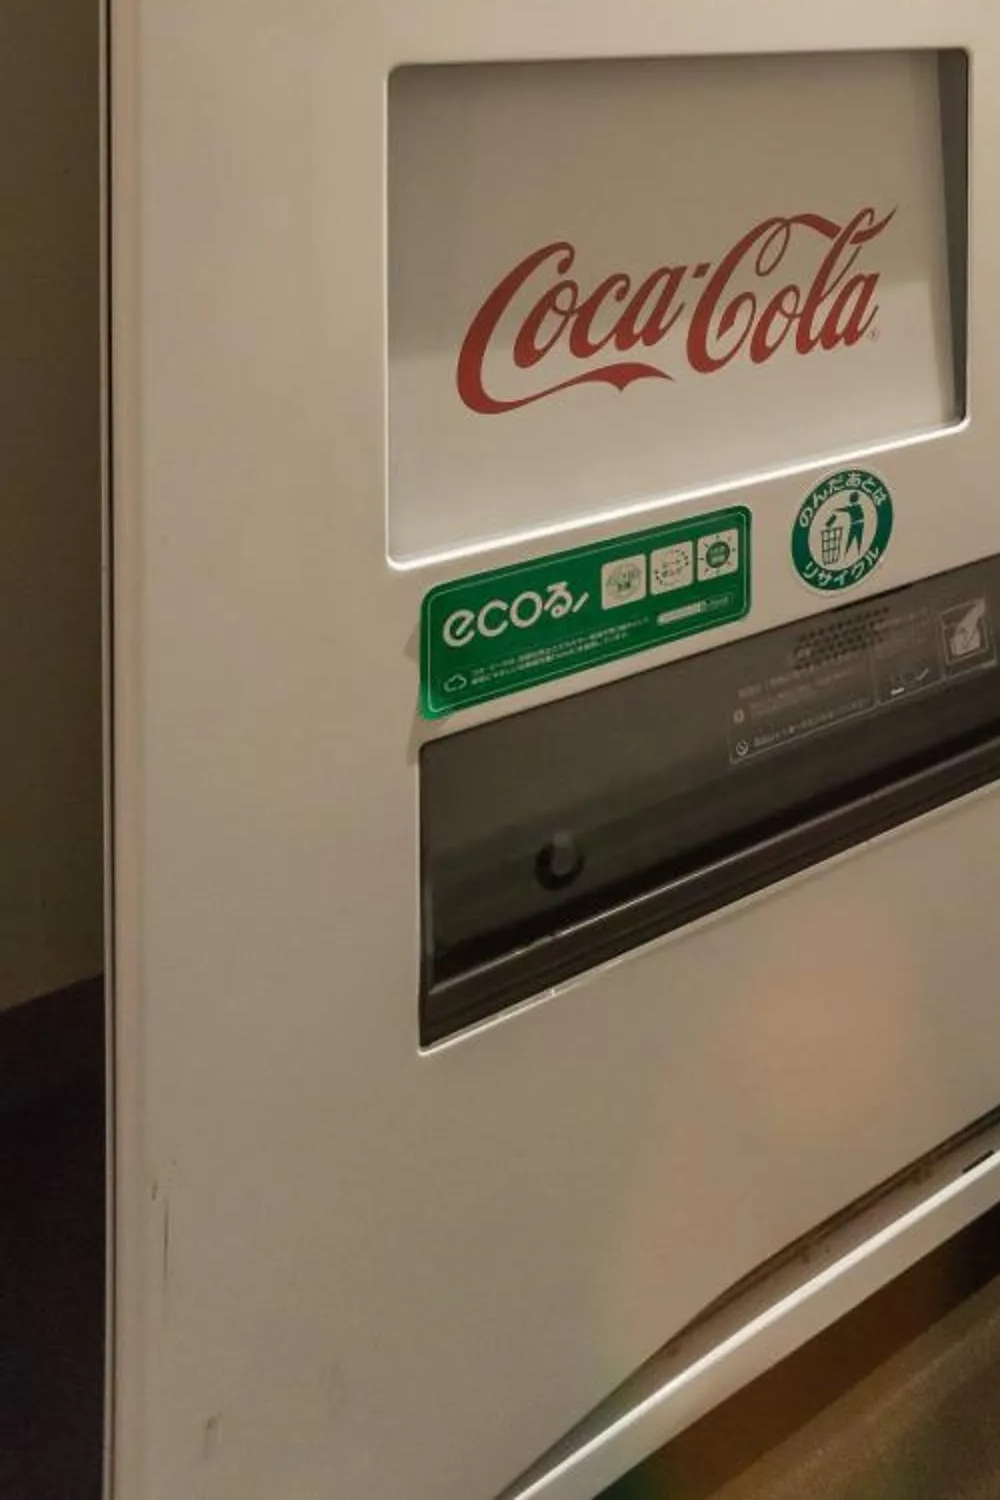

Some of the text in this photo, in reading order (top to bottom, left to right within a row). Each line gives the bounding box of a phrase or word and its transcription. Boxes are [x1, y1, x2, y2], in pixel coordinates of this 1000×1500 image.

[456, 202, 898, 415] Coca-Cola
[797, 468, 889, 529] のんだあとは
[803, 544, 883, 591] リサイクル
